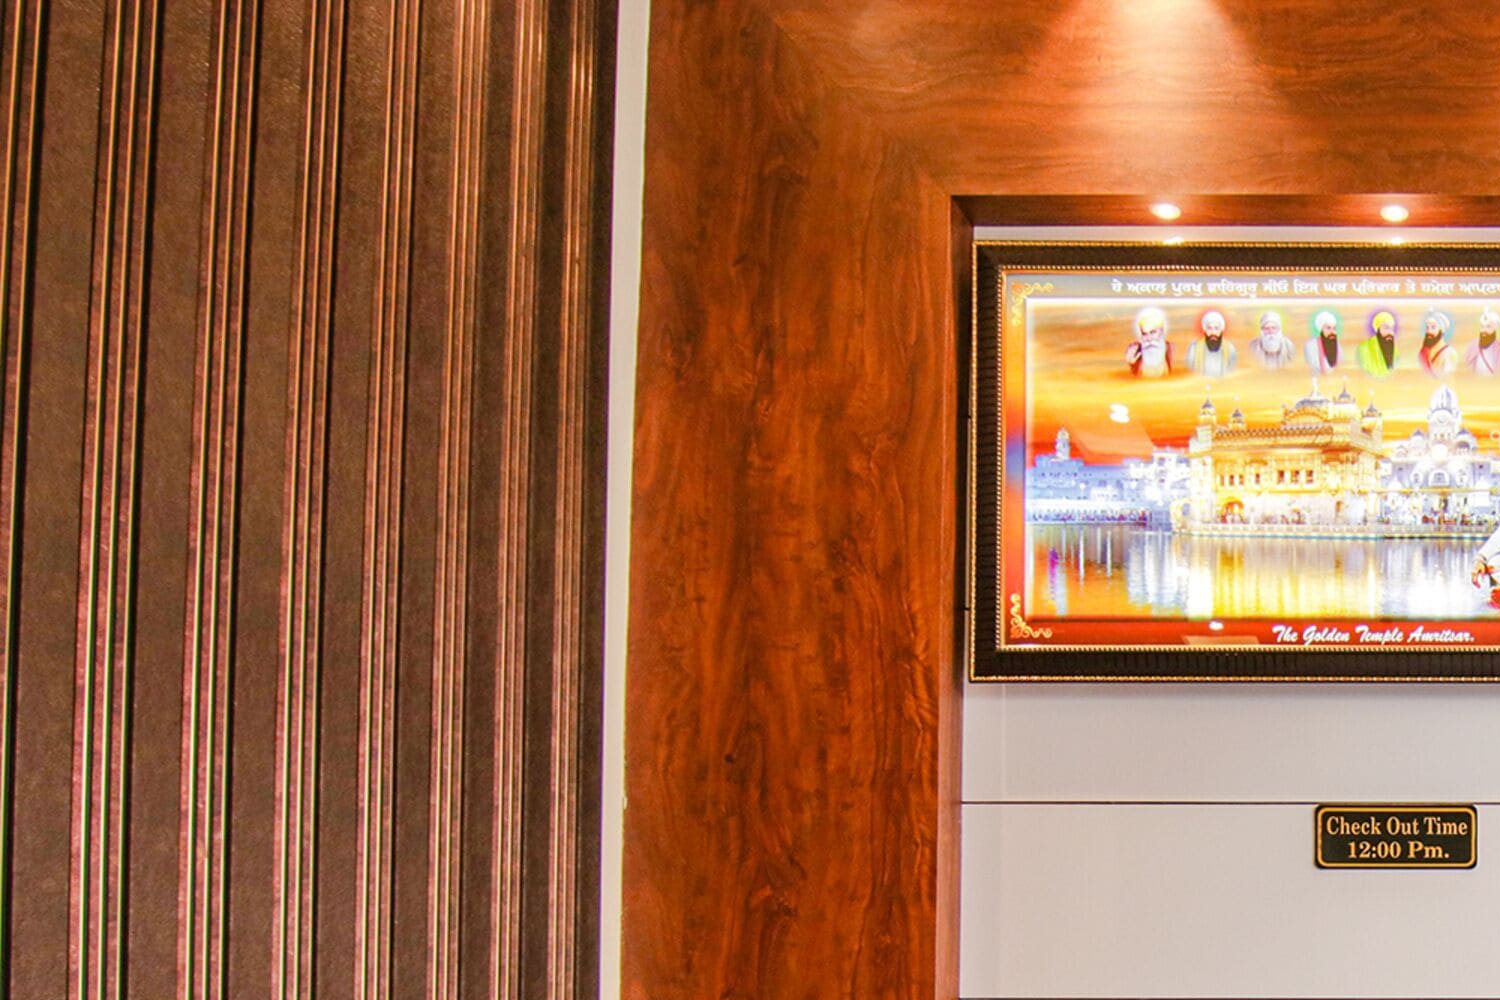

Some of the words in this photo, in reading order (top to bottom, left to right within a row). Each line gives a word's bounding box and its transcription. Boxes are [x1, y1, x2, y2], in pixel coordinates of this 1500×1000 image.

[1272, 625, 1298, 643] The
[1303, 625, 1350, 645] Golden
[1354, 625, 1404, 645] Temple
[1326, 816, 1382, 836] Check
[1386, 816, 1420, 836] Out
[1423, 816, 1468, 836] Time
[1348, 841, 1402, 859] 12:00
[1407, 841, 1450, 859] Pm.
